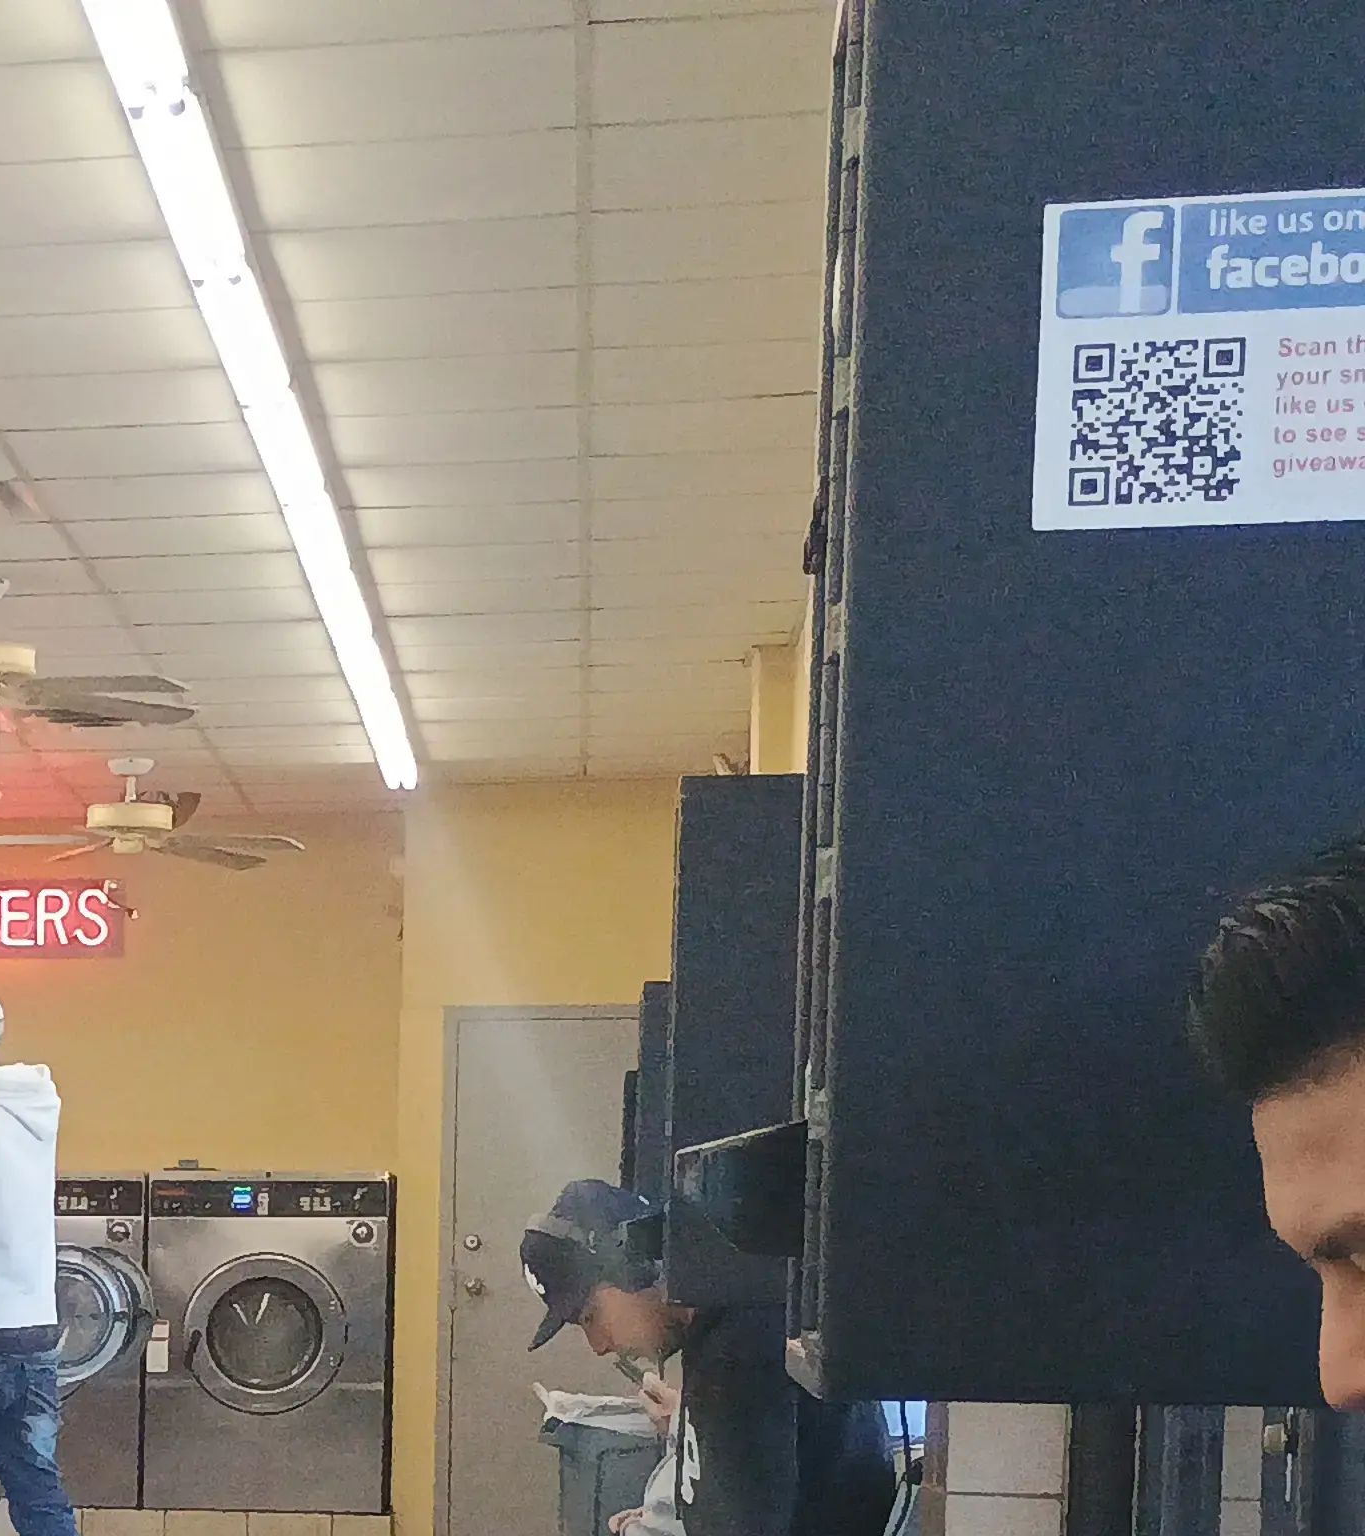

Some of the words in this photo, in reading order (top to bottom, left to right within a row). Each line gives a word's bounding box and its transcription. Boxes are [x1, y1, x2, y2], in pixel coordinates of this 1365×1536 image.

[1209, 208, 1268, 237] like
[1278, 211, 1314, 234] us
[1323, 209, 1365, 232] on
[1206, 240, 1365, 290] facebo
[1278, 337, 1337, 357] Scan
[1276, 369, 1332, 391] your
[1275, 396, 1317, 415] like
[1326, 398, 1355, 413] us
[1274, 426, 1297, 444] to
[1305, 427, 1347, 443] see
